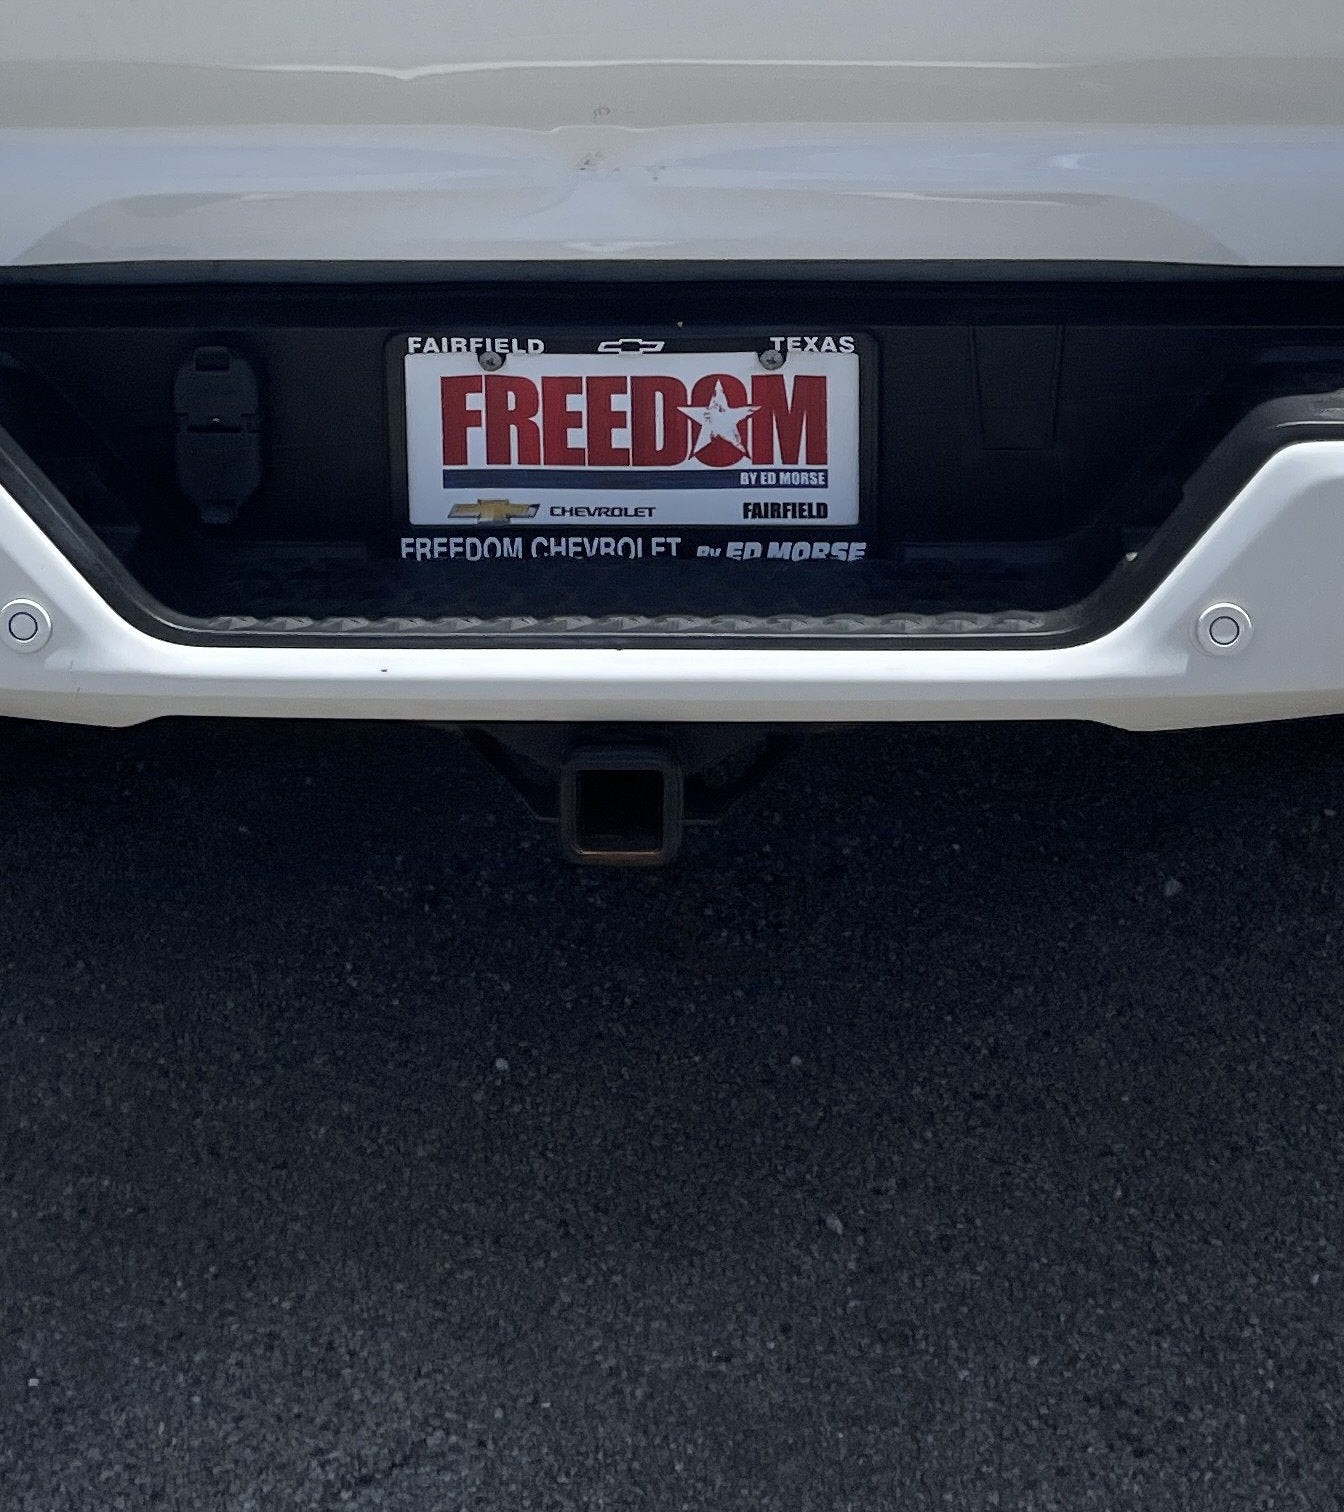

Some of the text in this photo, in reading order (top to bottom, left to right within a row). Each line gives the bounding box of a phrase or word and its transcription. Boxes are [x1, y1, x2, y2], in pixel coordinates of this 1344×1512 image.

[407, 335, 855, 355] FAIRFIELD TEXAS
[440, 374, 829, 468] FREEDOM
[740, 470, 826, 486] BY ED MORSE
[549, 505, 656, 519] CHEVROLET
[742, 501, 829, 520] FAIRFIELD
[401, 536, 523, 561] FREEDOM
[530, 536, 682, 559] CHEVROLET
[726, 541, 763, 561] ED
[767, 541, 867, 562] MORSE
